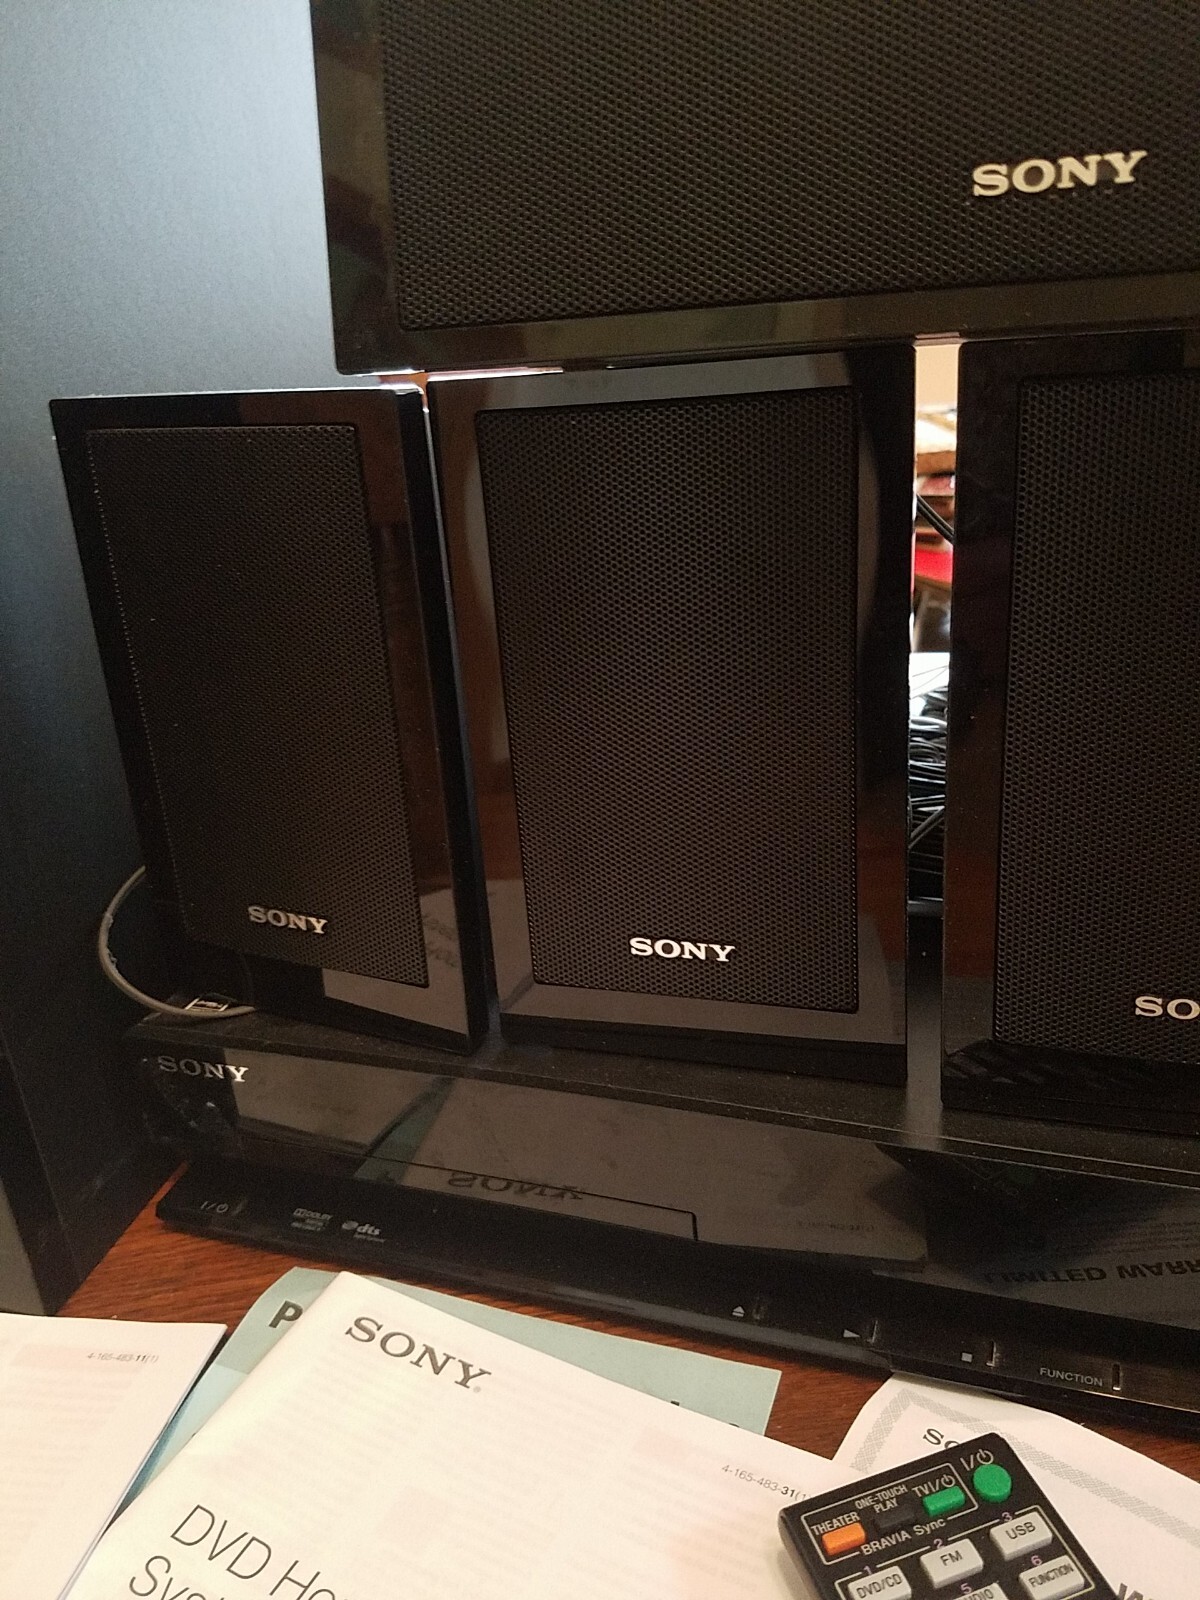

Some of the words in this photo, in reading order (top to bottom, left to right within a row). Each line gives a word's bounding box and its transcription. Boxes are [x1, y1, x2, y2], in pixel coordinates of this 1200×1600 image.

[972, 150, 1148, 196] SONY
[248, 905, 328, 934] SONY
[629, 937, 735, 962] SONY
[1135, 995, 1200, 1020] SO
[158, 1055, 249, 1082] SONY
[356, 1223, 382, 1236] dts
[345, 1315, 492, 1389] SONY
[1039, 1367, 1103, 1387] FUNCTION
[854, 1484, 909, 1510] ONE-TOUCH
[874, 1496, 900, 1514] PLAY
[811, 1511, 861, 1536] THEATER
[1001, 1511, 1013, 1522] 3
[170, 1504, 273, 1580] DVD
[860, 1530, 912, 1556] BRAVIA
[913, 1518, 947, 1538] Sync
[1005, 1521, 1036, 1540] USB
[933, 1538, 944, 1549] 2
[863, 1565, 874, 1575] 1
[939, 1549, 963, 1567] FM
[1031, 1555, 1043, 1566] 6
[855, 1572, 904, 1599] DVD/CD
[1028, 1561, 1075, 1588] FUNCTION
[960, 1582, 972, 1595] 5
